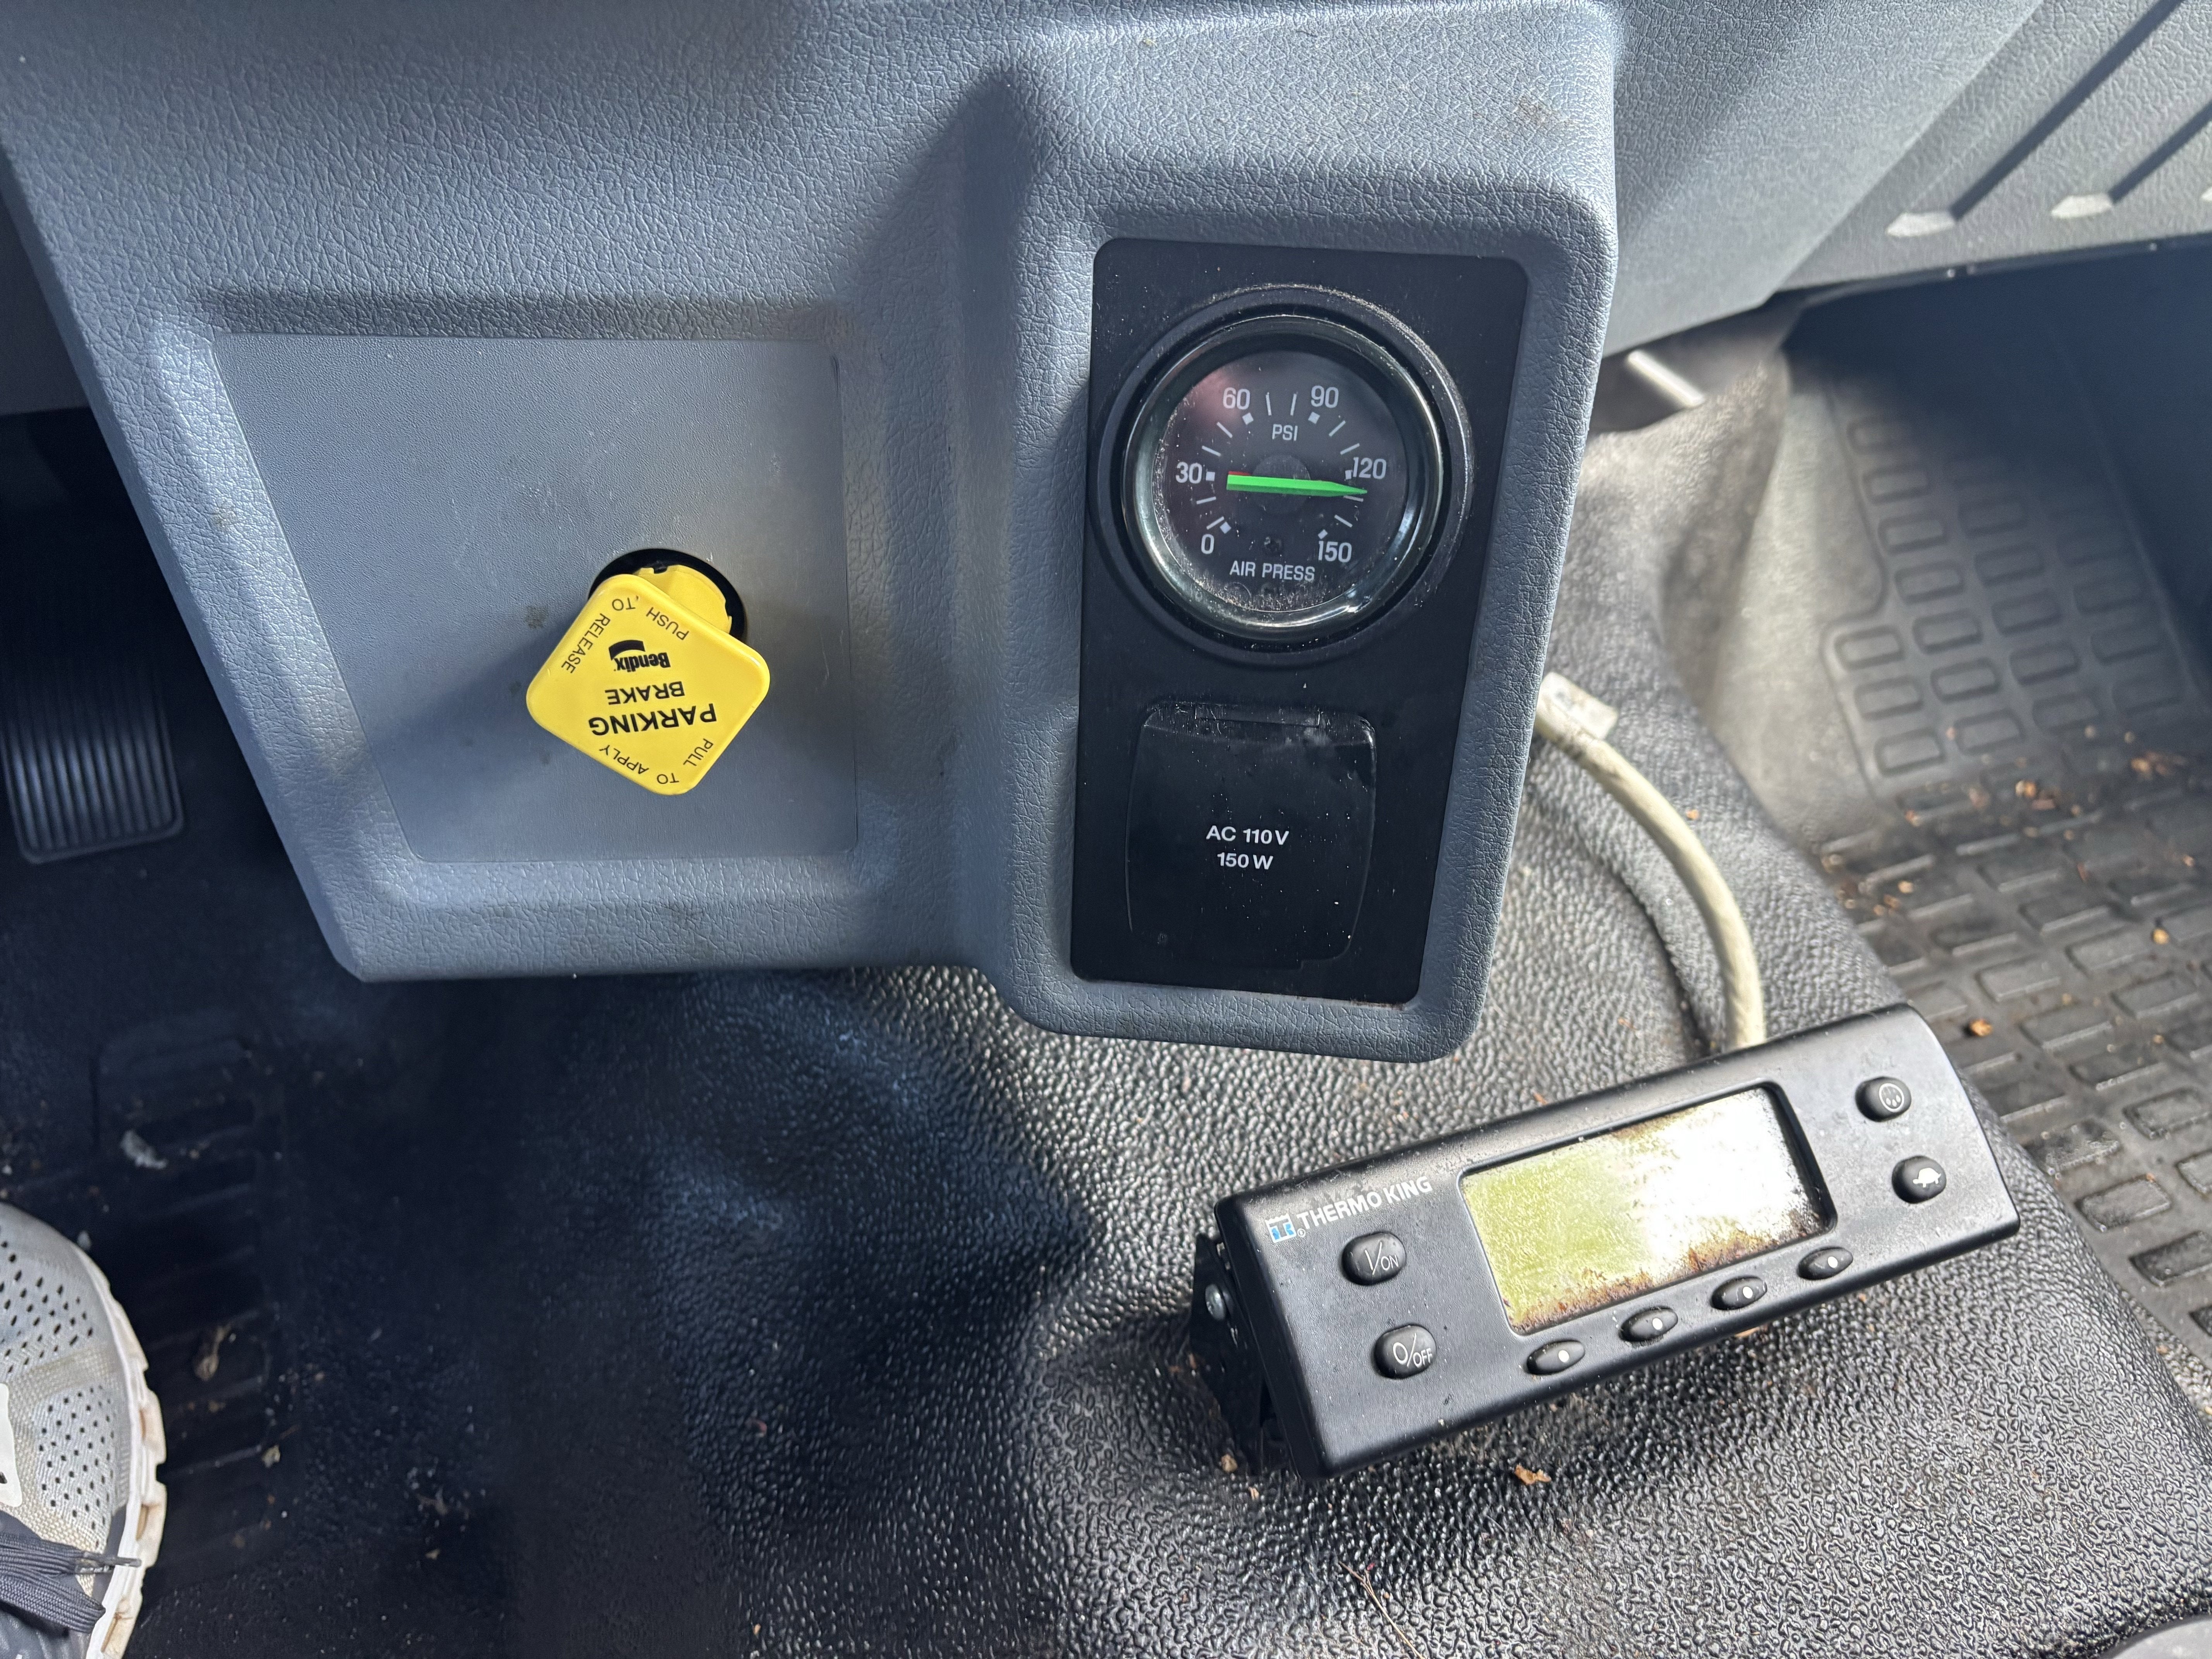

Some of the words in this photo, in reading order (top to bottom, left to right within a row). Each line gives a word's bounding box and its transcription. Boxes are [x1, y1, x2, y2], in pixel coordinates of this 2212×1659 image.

[1223, 388, 1250, 410] 60
[1311, 386, 1339, 408] 90
[1271, 424, 1298, 441] PSI
[1176, 463, 1202, 483] 30
[1352, 457, 1386, 480] 120
[1200, 534, 1214, 554] 0
[1317, 541, 1352, 562] 150
[1230, 560, 1255, 576] AIR
[1262, 563, 1315, 581] PRESS
[611, 597, 636, 611] TO
[646, 607, 689, 641] PUSH
[561, 613, 611, 673] RELEASE
[614, 652, 671, 673] Bendix
[605, 681, 685, 705] BRAKE
[588, 703, 717, 736] PARKING
[599, 745, 649, 775] APPLY
[683, 738, 714, 767] PULL
[656, 772, 680, 784] TO
[1206, 825, 1236, 841] AC
[1296, 1191, 1382, 1230] THERMO
[1383, 1176, 1433, 1204] KING
